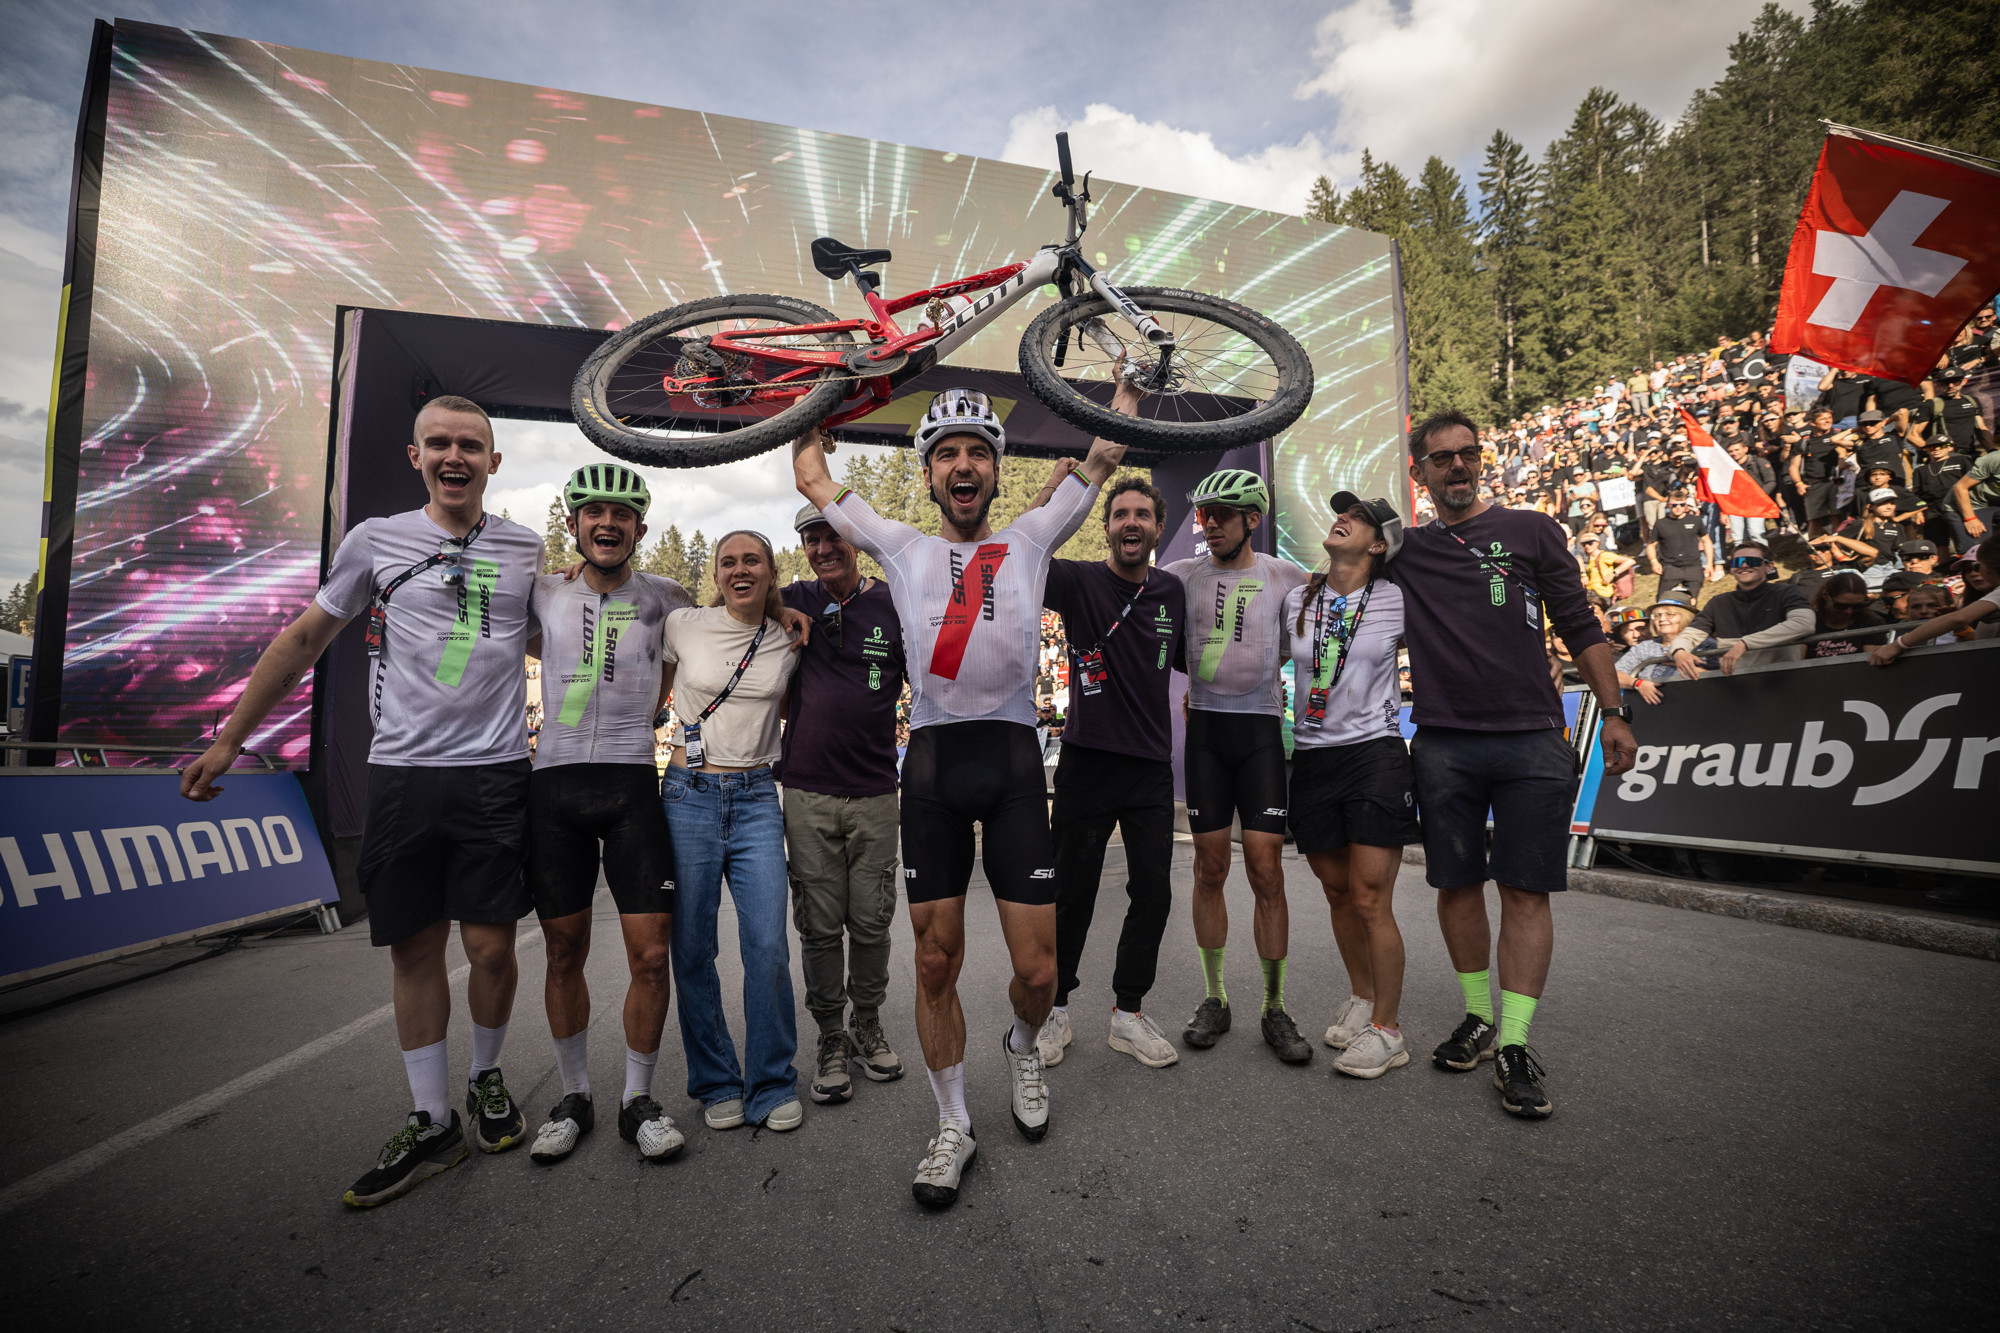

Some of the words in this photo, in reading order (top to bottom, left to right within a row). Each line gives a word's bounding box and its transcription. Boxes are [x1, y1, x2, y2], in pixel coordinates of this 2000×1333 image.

[730, 341, 780, 353] SCOTT
[1243, 486, 1265, 495] SCOTT
[949, 548, 967, 607] SCOTT
[980, 563, 995, 622] SRAM
[478, 583, 491, 639] SRAM
[1215, 580, 1227, 632] SCOTT
[1233, 595, 1247, 643] SRAM
[582, 602, 594, 667] SCOTT
[603, 626, 618, 683] SRAM
[862, 649, 888, 657] SRAM
[863, 637, 890, 645] SCOTT
[0, 814, 303, 909] HIMANO
